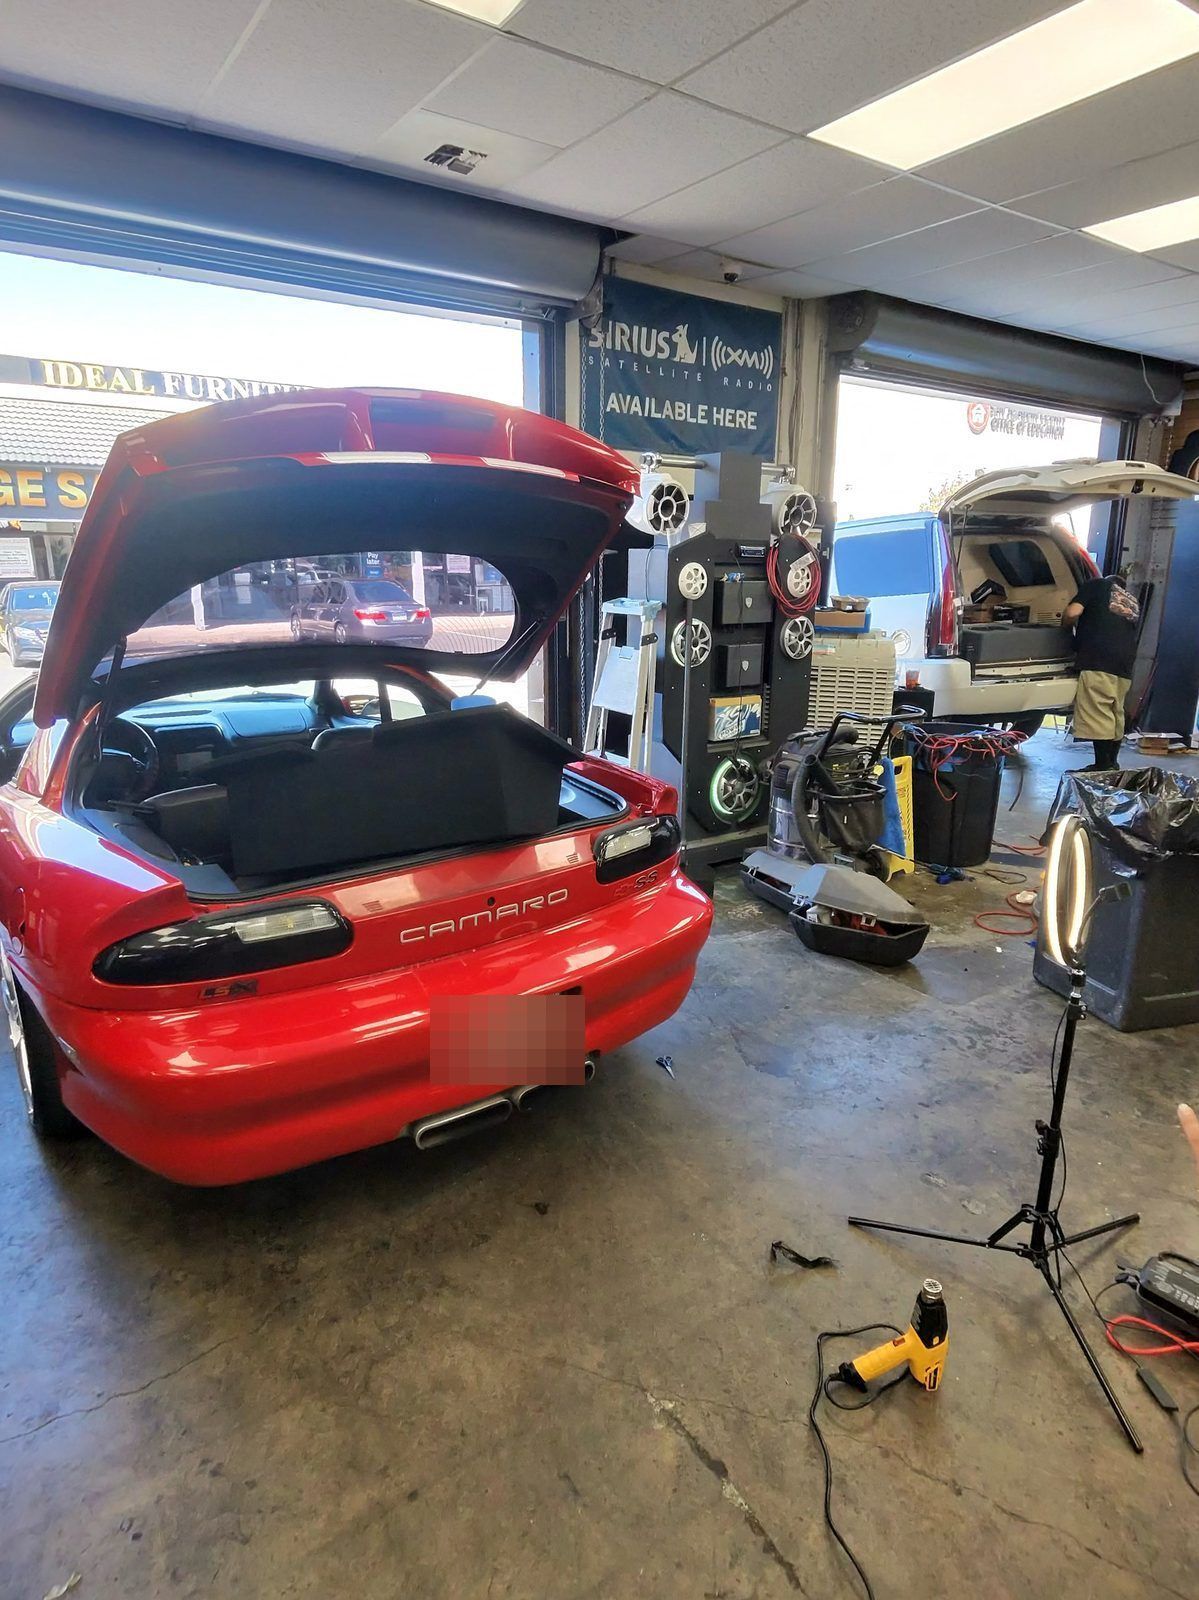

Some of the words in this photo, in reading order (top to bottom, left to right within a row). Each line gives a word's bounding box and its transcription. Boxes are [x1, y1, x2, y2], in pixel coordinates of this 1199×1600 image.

[588, 320, 671, 361] SIRIUS
[40, 359, 156, 395] IDEAL
[161, 371, 314, 401] FURNI
[588, 355, 703, 382] SATELLITE
[722, 376, 773, 392] RADIO
[606, 392, 709, 425] AVAILABLE
[713, 406, 758, 430] HERE
[400, 888, 568, 944] CAMARO
